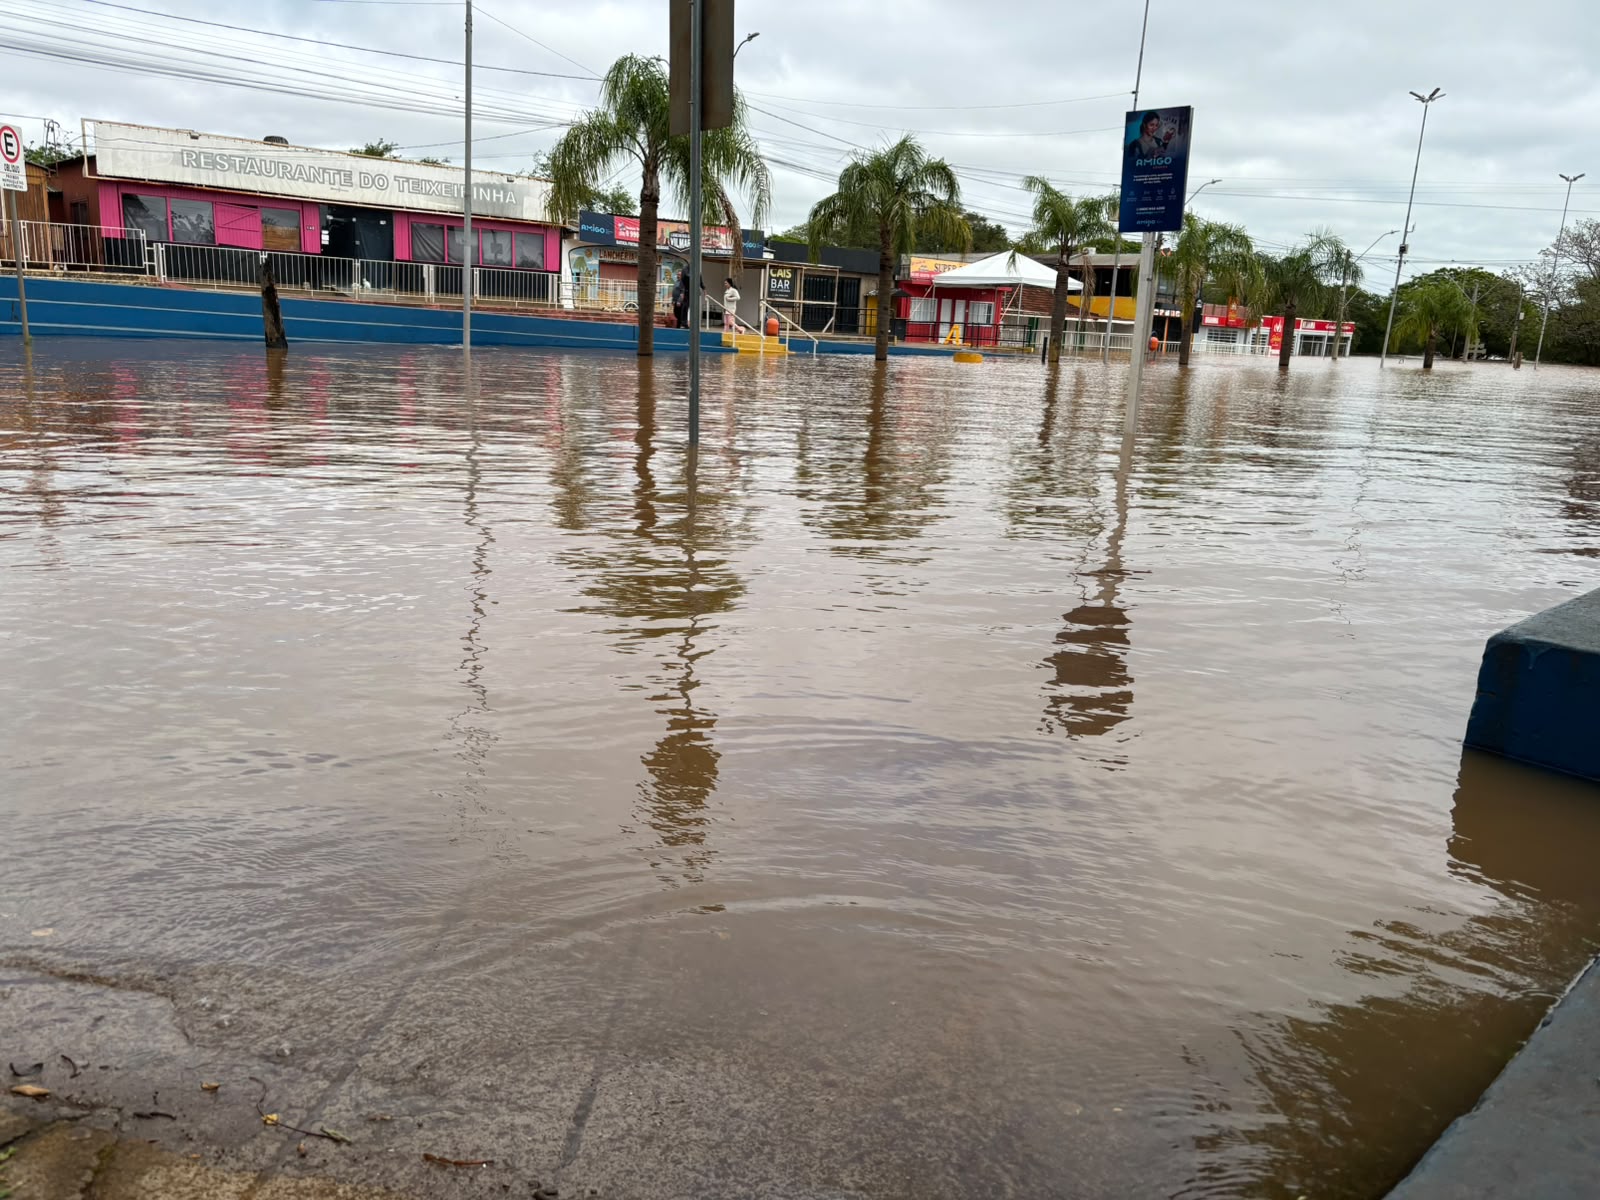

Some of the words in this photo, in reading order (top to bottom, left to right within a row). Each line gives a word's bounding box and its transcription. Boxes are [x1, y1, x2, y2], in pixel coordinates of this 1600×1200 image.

[4, 132, 15, 156] E
[1135, 155, 1173, 167] AMIGO
[181, 149, 353, 187] RESTAURANTE
[359, 172, 390, 190] DO
[770, 268, 792, 279] CAIS
[770, 279, 790, 290] BAR
